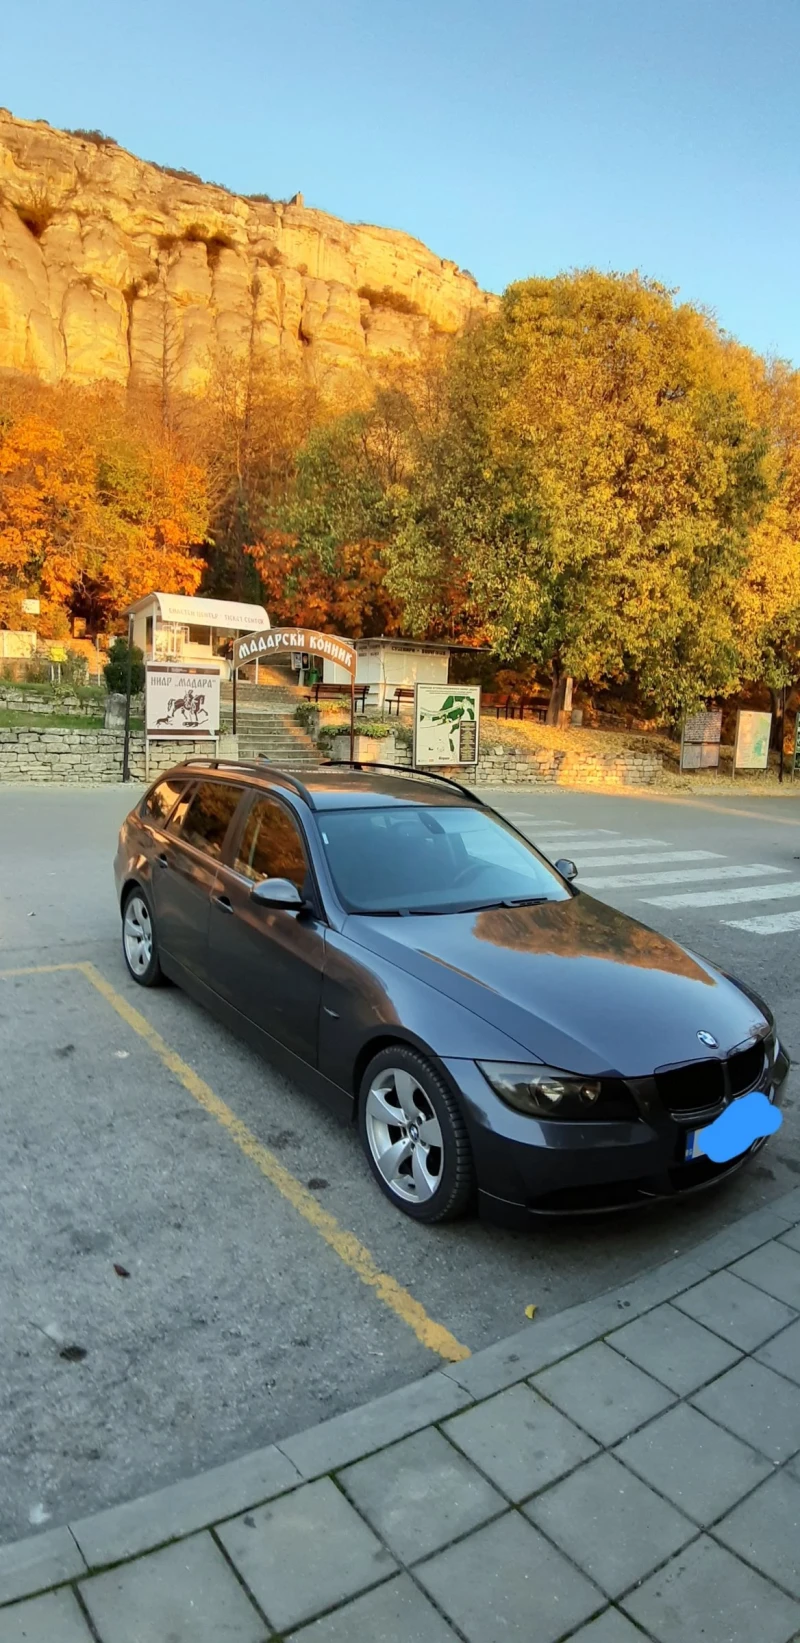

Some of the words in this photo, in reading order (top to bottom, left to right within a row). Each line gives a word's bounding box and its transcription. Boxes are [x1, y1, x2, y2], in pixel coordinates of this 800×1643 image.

[238, 633, 305, 659] МАДАРСКИ
[309, 636, 353, 667] КОННИК
[151, 676, 172, 687] НИАР
